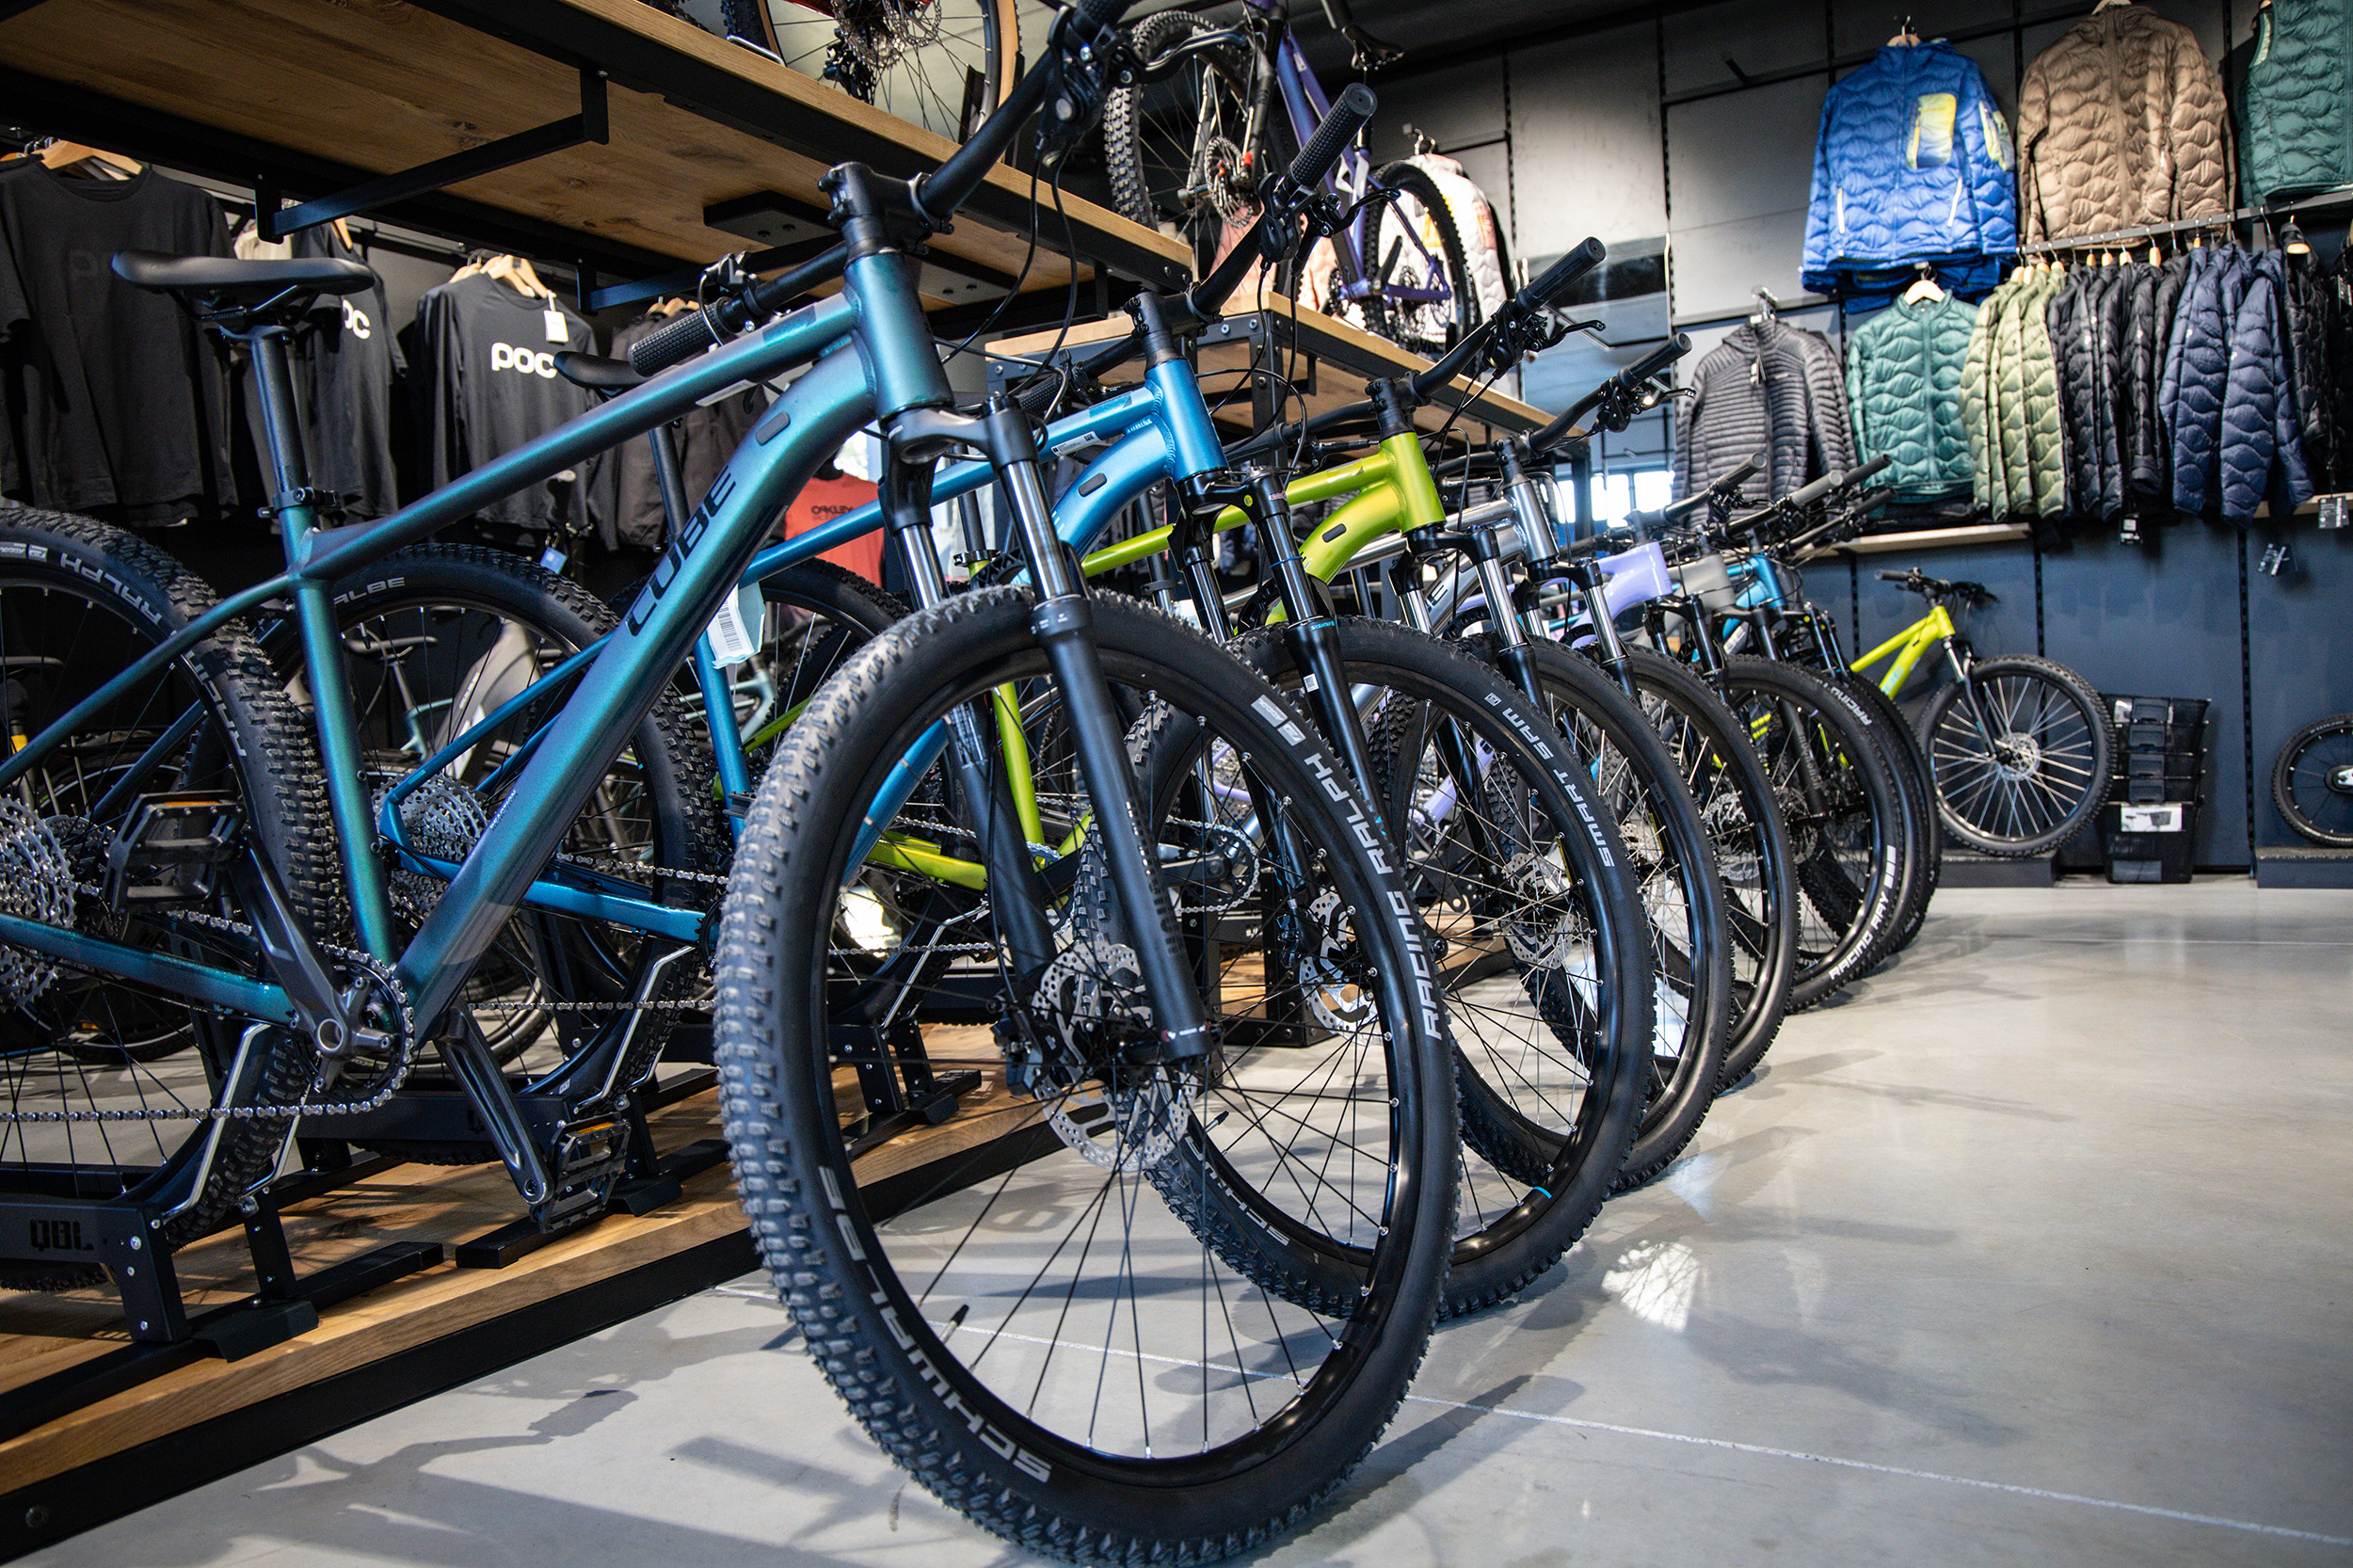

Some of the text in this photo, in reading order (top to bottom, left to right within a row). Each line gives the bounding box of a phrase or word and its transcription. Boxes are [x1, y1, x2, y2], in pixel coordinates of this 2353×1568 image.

[60, 552, 163, 626] RALPH
[333, 576, 406, 606] ALBE
[625, 465, 737, 637] CUBE
[170, 630, 248, 758] RACIN
[1830, 685, 1873, 727] RACING
[1304, 752, 1394, 875] RALPH
[1501, 707, 1616, 868] SMART SAM
[1386, 890, 1443, 1041] RACING
[1828, 890, 1890, 981] RACING RAY
[1184, 1135, 1290, 1247] SCHWA
[818, 1165, 1052, 1483] SCHWALBE
